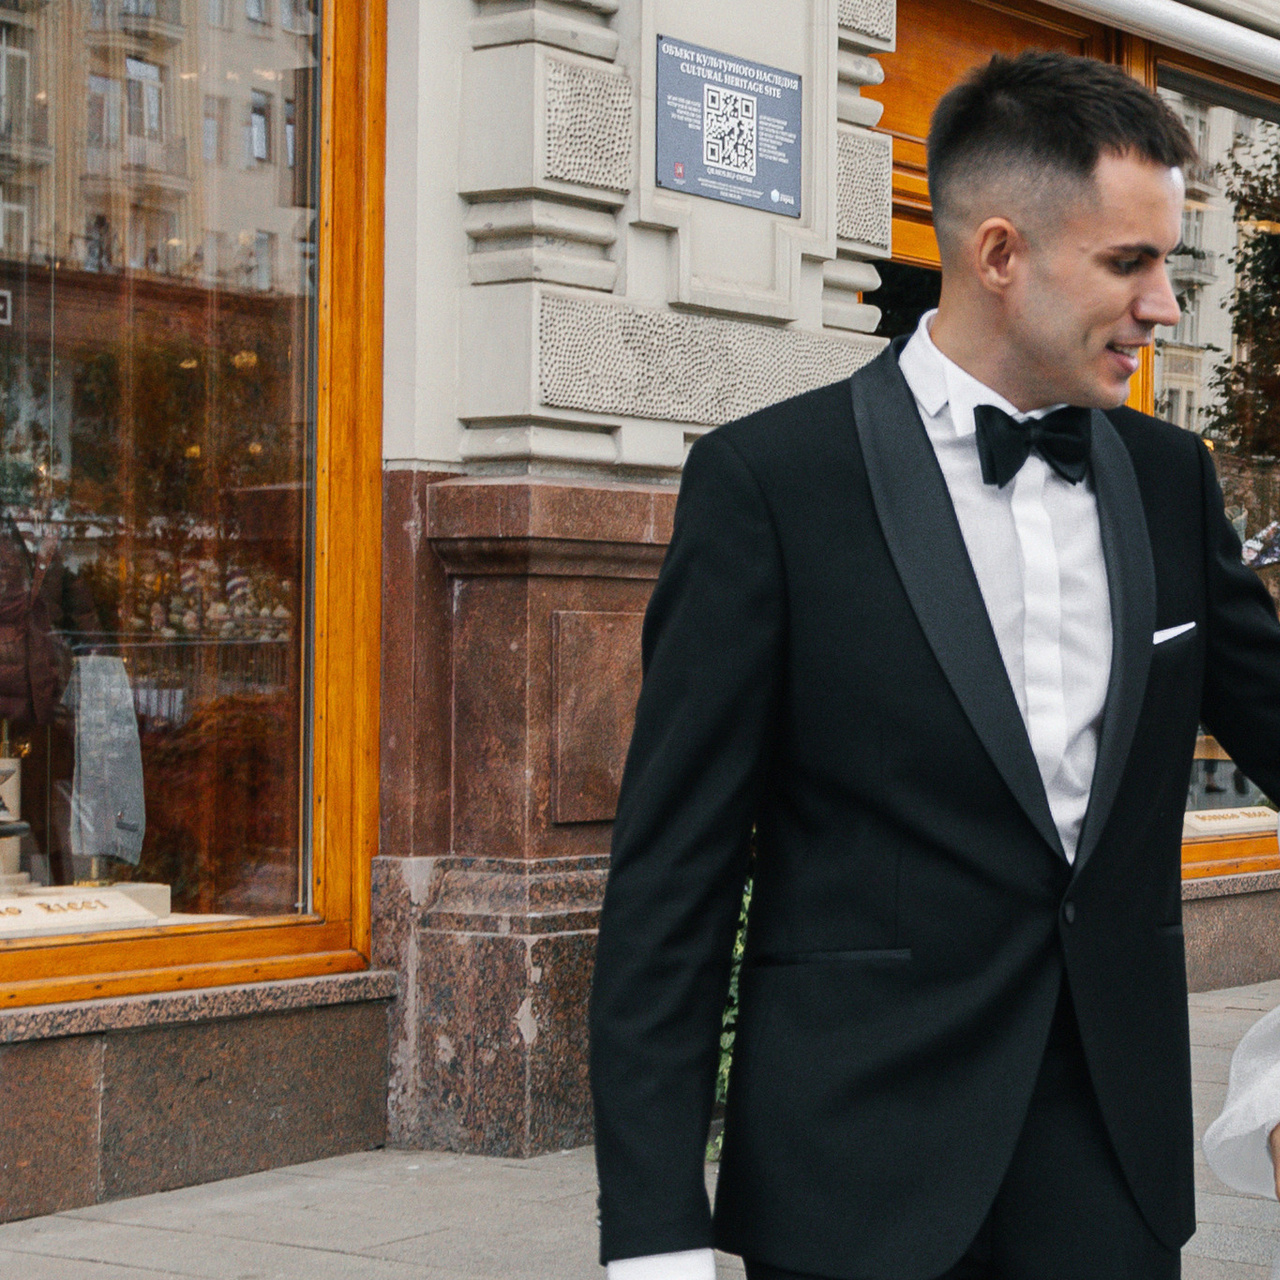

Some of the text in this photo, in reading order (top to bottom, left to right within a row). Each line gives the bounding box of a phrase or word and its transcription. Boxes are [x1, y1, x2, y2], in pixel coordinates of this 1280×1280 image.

[661, 42, 799, 91] ОБЪЕКТ КУЛЬТУРНОГО НАСЛЕДИЯ
[680, 61, 782, 99] CULTURAL HERITAGE SITE
